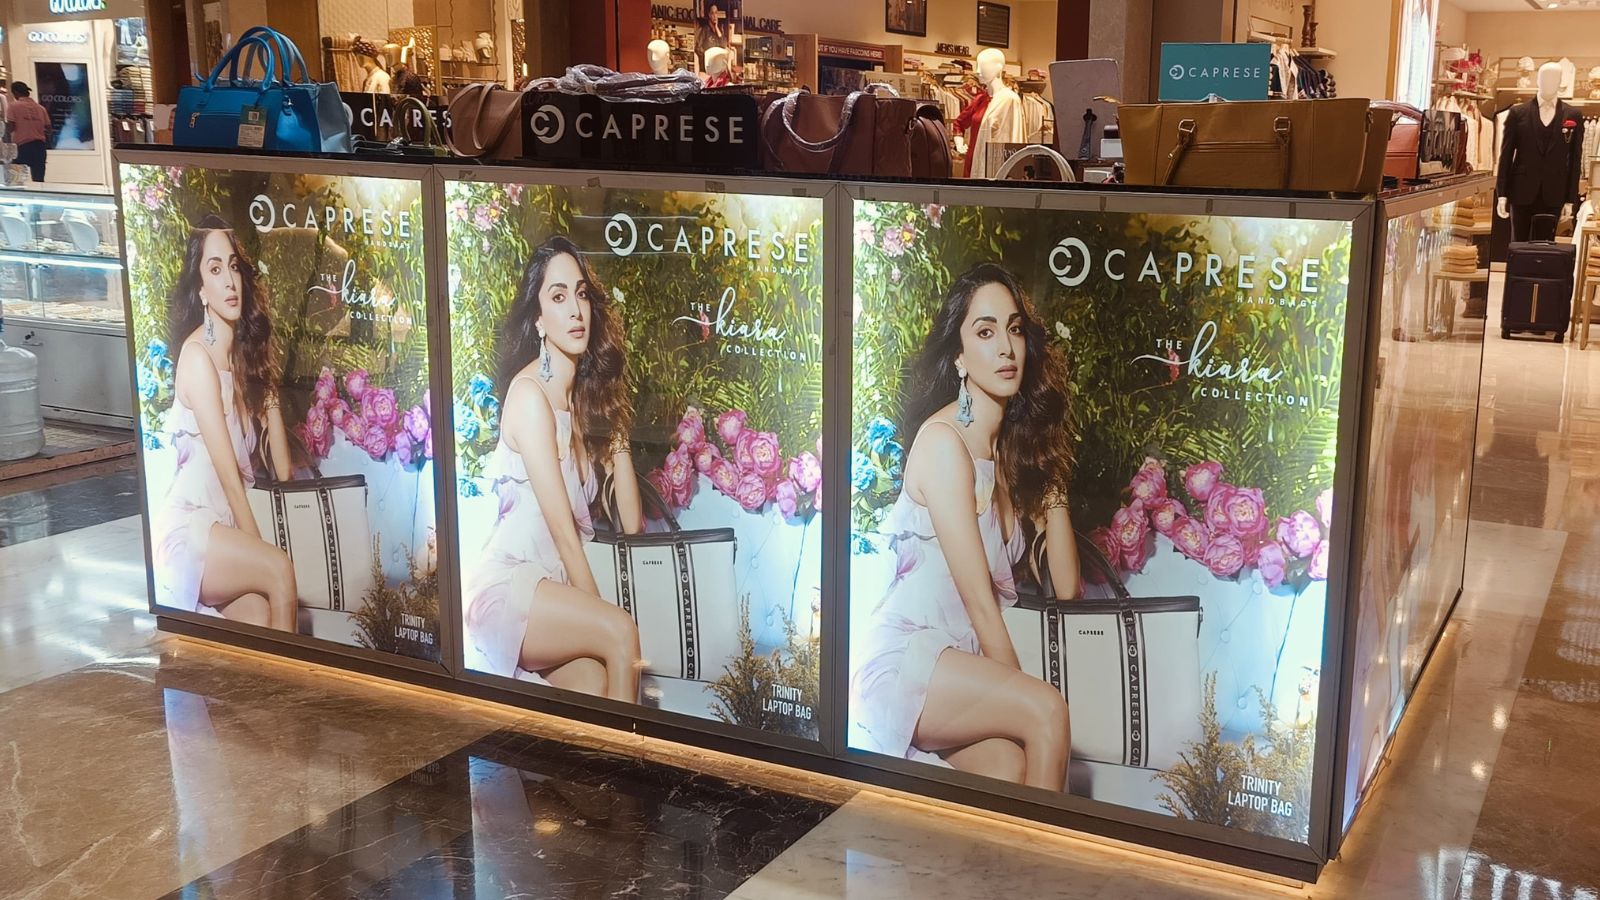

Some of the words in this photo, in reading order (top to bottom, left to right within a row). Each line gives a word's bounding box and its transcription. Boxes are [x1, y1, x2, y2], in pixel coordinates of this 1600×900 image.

[651, 4, 673, 18] ANIC
[1188, 67, 1261, 78] CAPRESE
[575, 112, 745, 144] CAPRESE
[283, 203, 410, 238] CAPRESE
[647, 222, 809, 263] CAPRESE
[320, 273, 337, 282] THE
[1104, 248, 1321, 293] CAPRESE
[690, 301, 711, 312] THE
[726, 344, 807, 361] COLLECTION
[1156, 338, 1183, 350] THE
[1200, 387, 1309, 407] COLLECTION
[401, 612, 426, 629] TRINITY
[683, 589, 693, 642] CAPRESE
[394, 625, 419, 642] LAPTOP
[420, 631, 433, 645] BAG
[772, 683, 803, 703] TRINITY
[1130, 664, 1140, 725] CAPRESE
[762, 698, 794, 716] LAPTOP
[795, 705, 812, 720] BAG
[1241, 774, 1282, 796] TRINITY
[1228, 790, 1269, 812] LAPTOP
[1270, 799, 1292, 817] BAG
